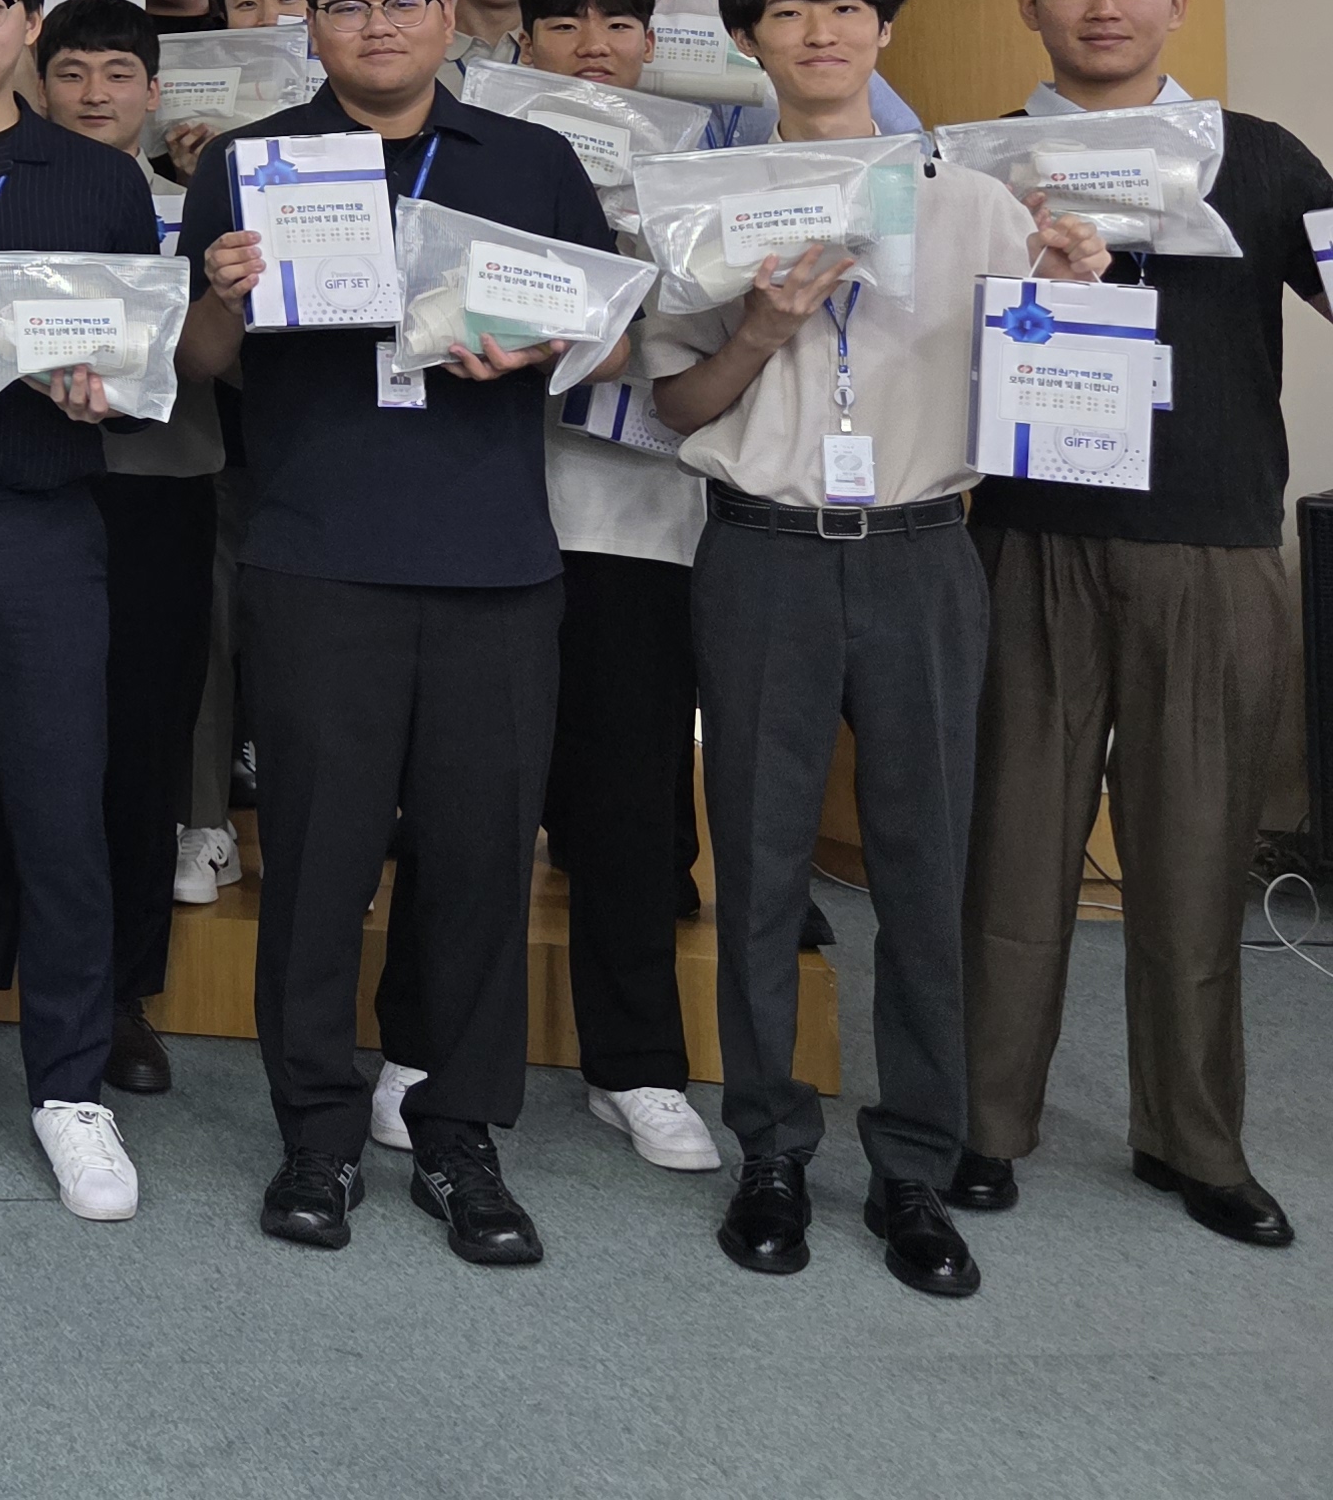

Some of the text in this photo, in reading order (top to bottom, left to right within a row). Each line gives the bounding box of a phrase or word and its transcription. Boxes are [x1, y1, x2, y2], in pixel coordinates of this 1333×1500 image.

[325, 279, 369, 289] GIFT SET
[1064, 437, 1116, 450] GIFT SET
